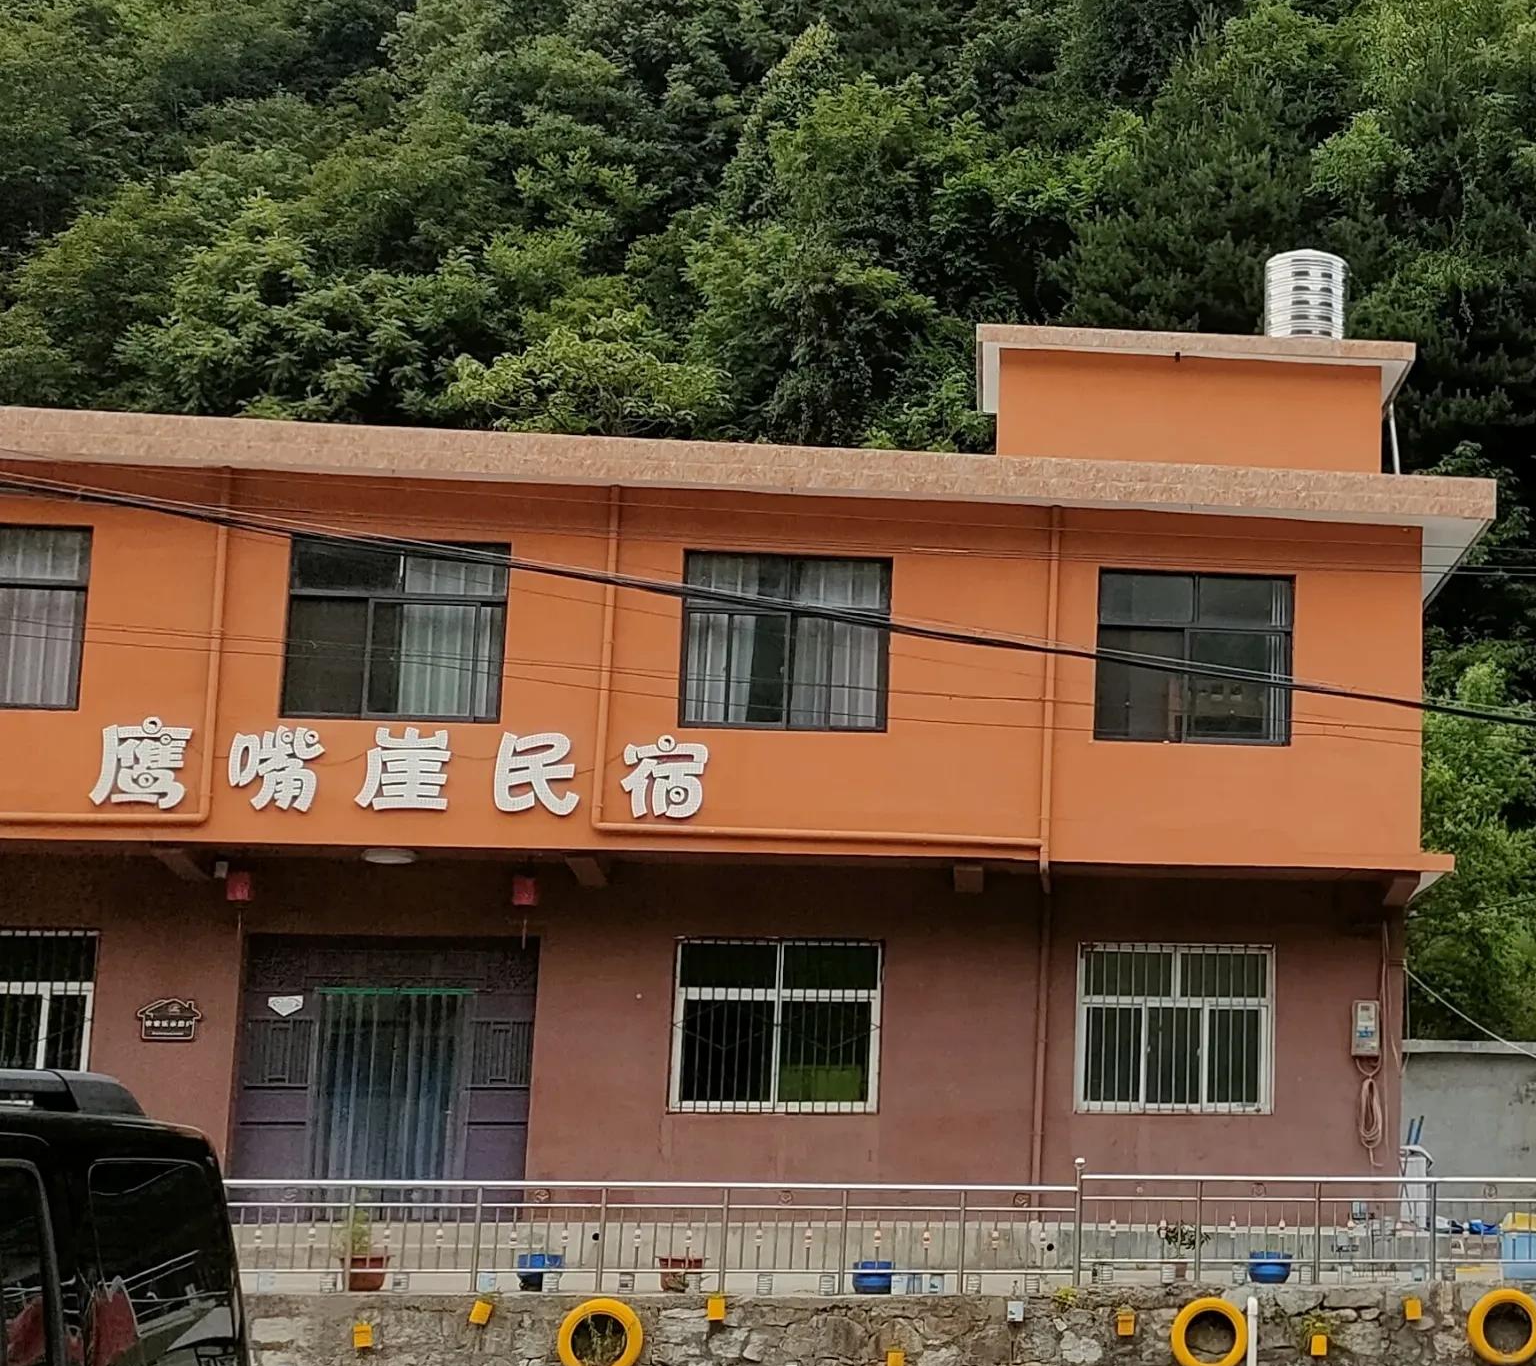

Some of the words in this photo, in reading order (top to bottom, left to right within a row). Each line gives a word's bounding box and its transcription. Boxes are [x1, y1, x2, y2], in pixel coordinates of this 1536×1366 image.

[89, 716, 710, 819] 鹰嘴崖民宿
